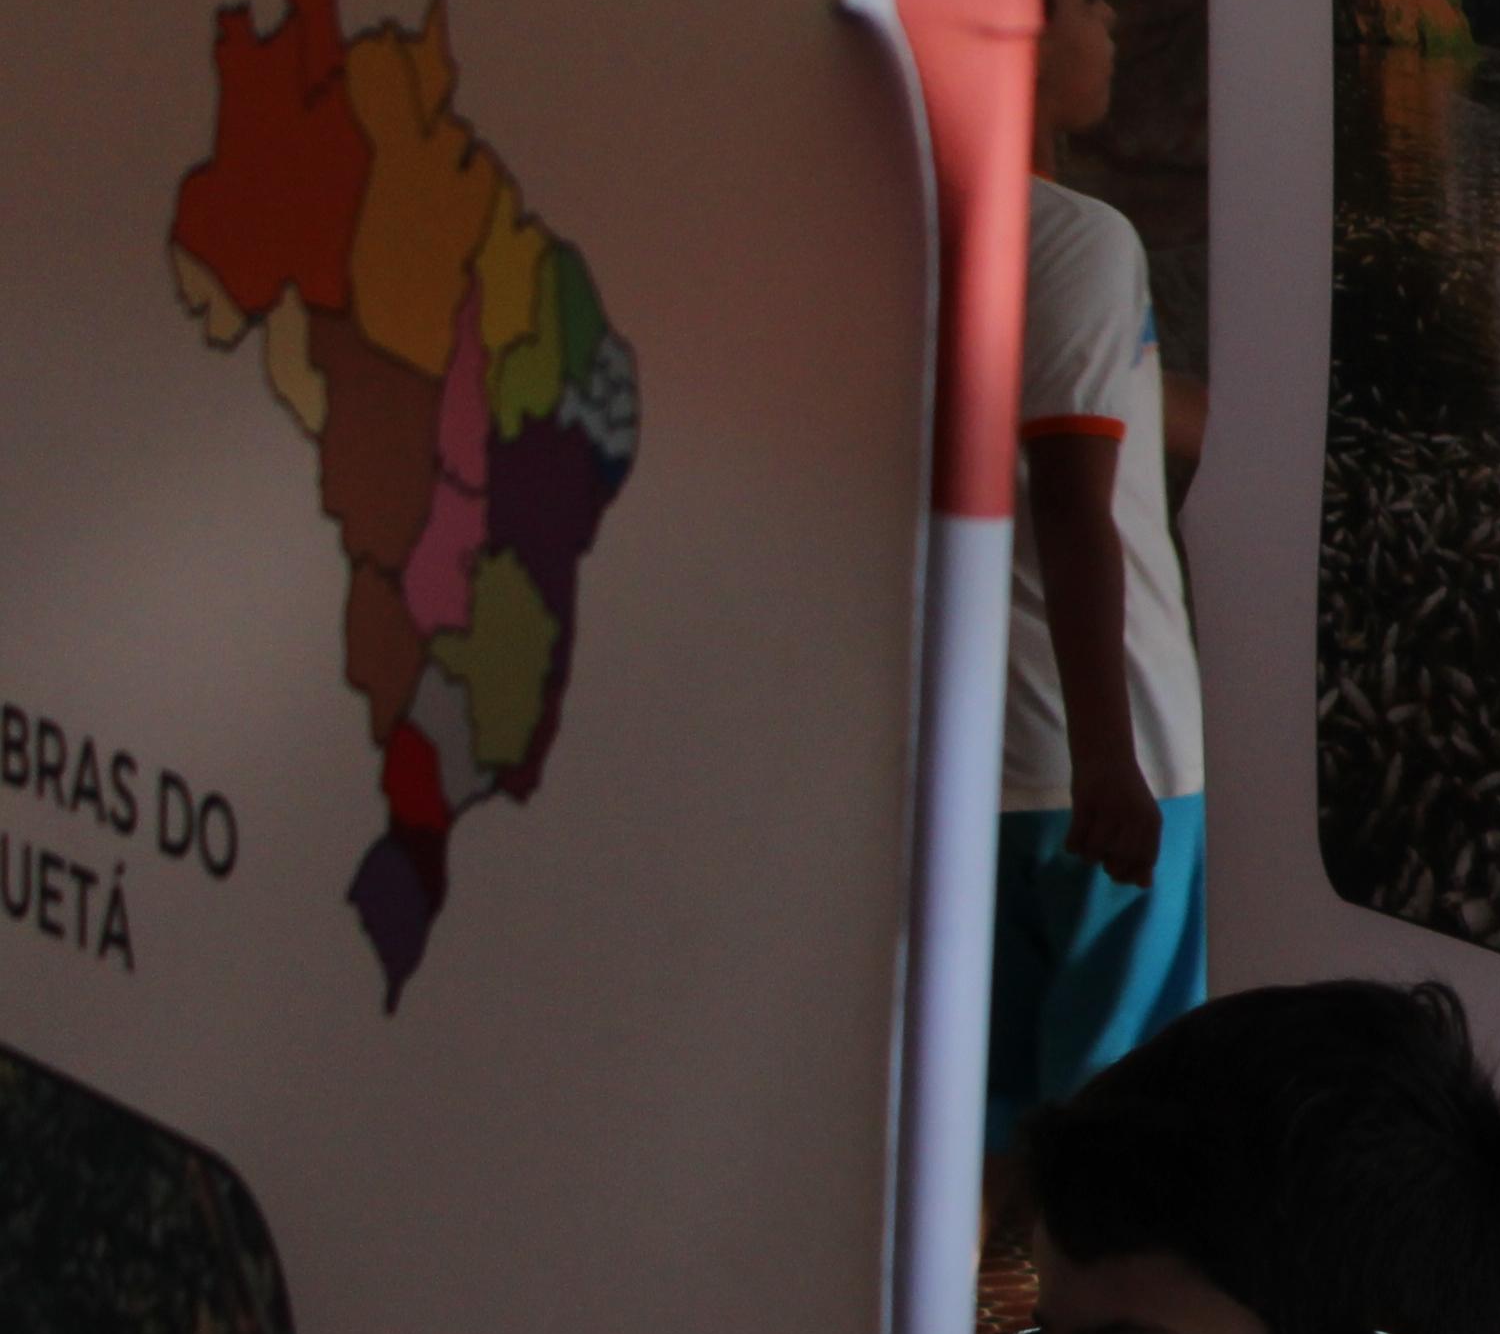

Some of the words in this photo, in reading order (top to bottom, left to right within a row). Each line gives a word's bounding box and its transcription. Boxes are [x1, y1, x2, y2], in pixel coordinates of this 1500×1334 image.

[1, 700, 140, 836] BRAS
[157, 769, 239, 881] DO
[0, 832, 136, 973] UETÁ
